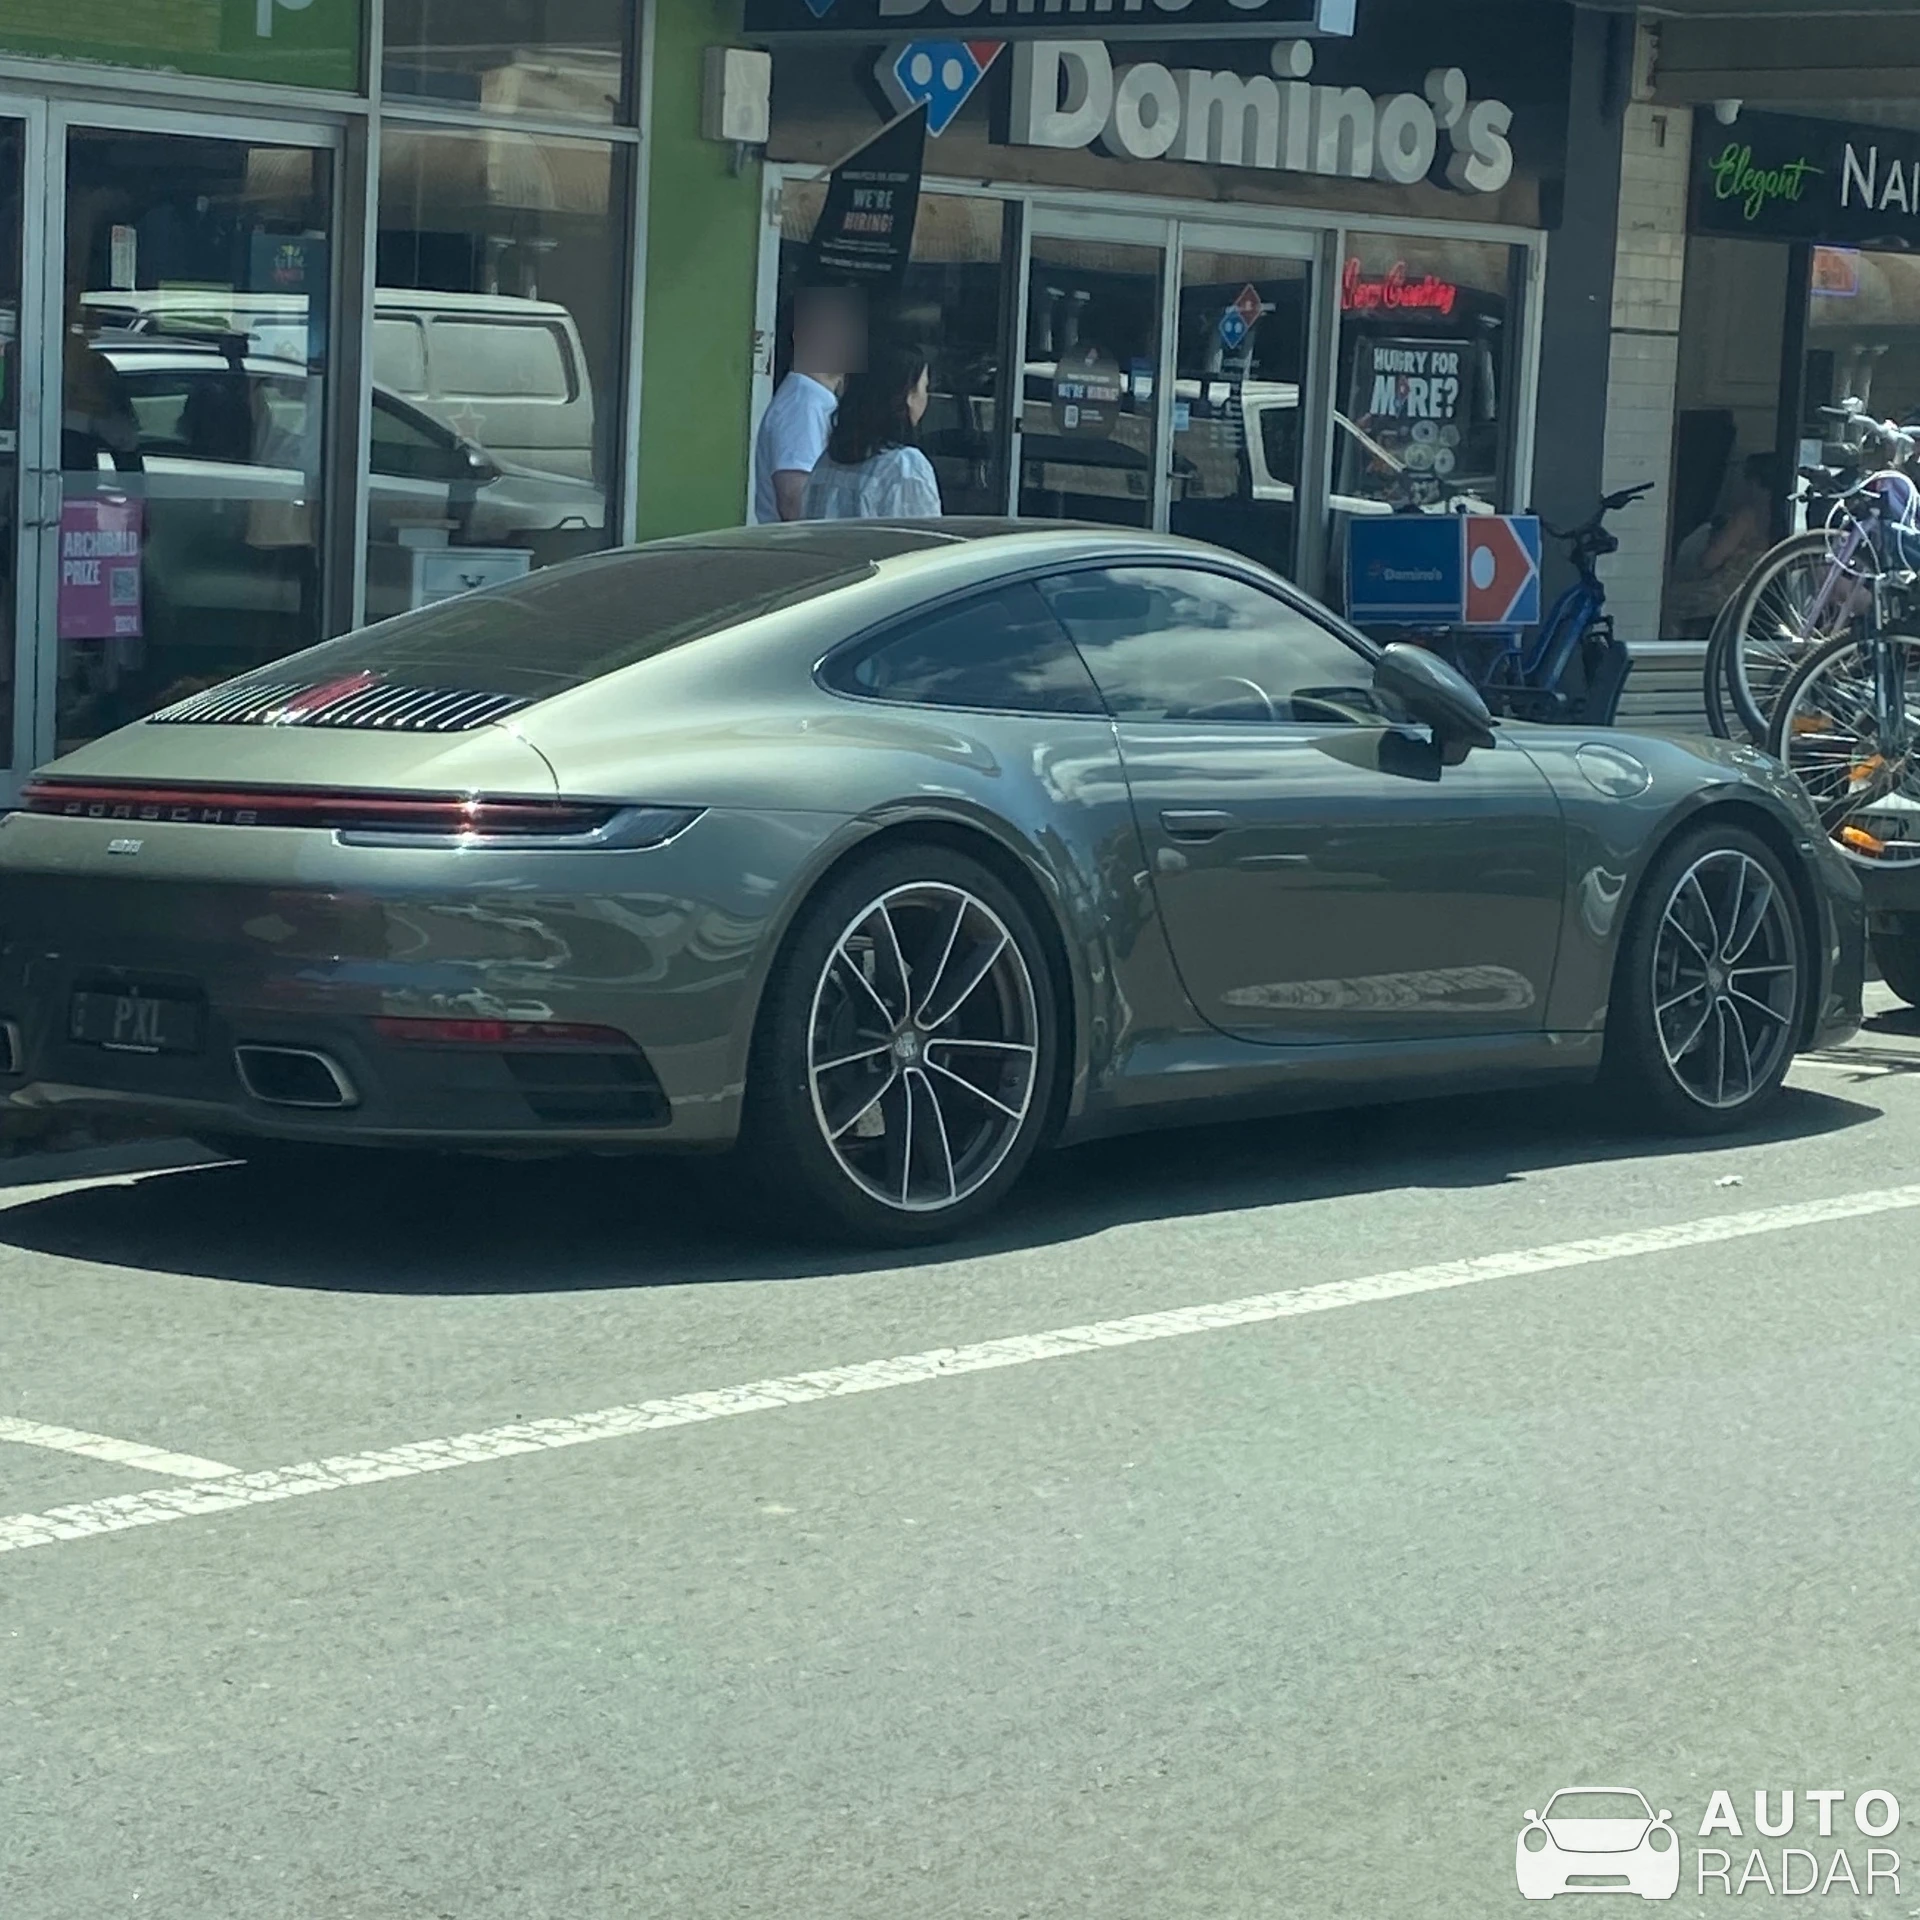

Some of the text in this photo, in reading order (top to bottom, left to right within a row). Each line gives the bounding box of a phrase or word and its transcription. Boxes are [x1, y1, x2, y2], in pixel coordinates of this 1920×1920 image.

[1020, 40, 1514, 192] Domino's
[1709, 142, 1825, 220] Elegant
[853, 188, 894, 209] WE'RE
[1373, 347, 1459, 375] HUNGRY FOR
[63, 559, 101, 586] PRIZE
[64, 802, 258, 825] PORSCHE
